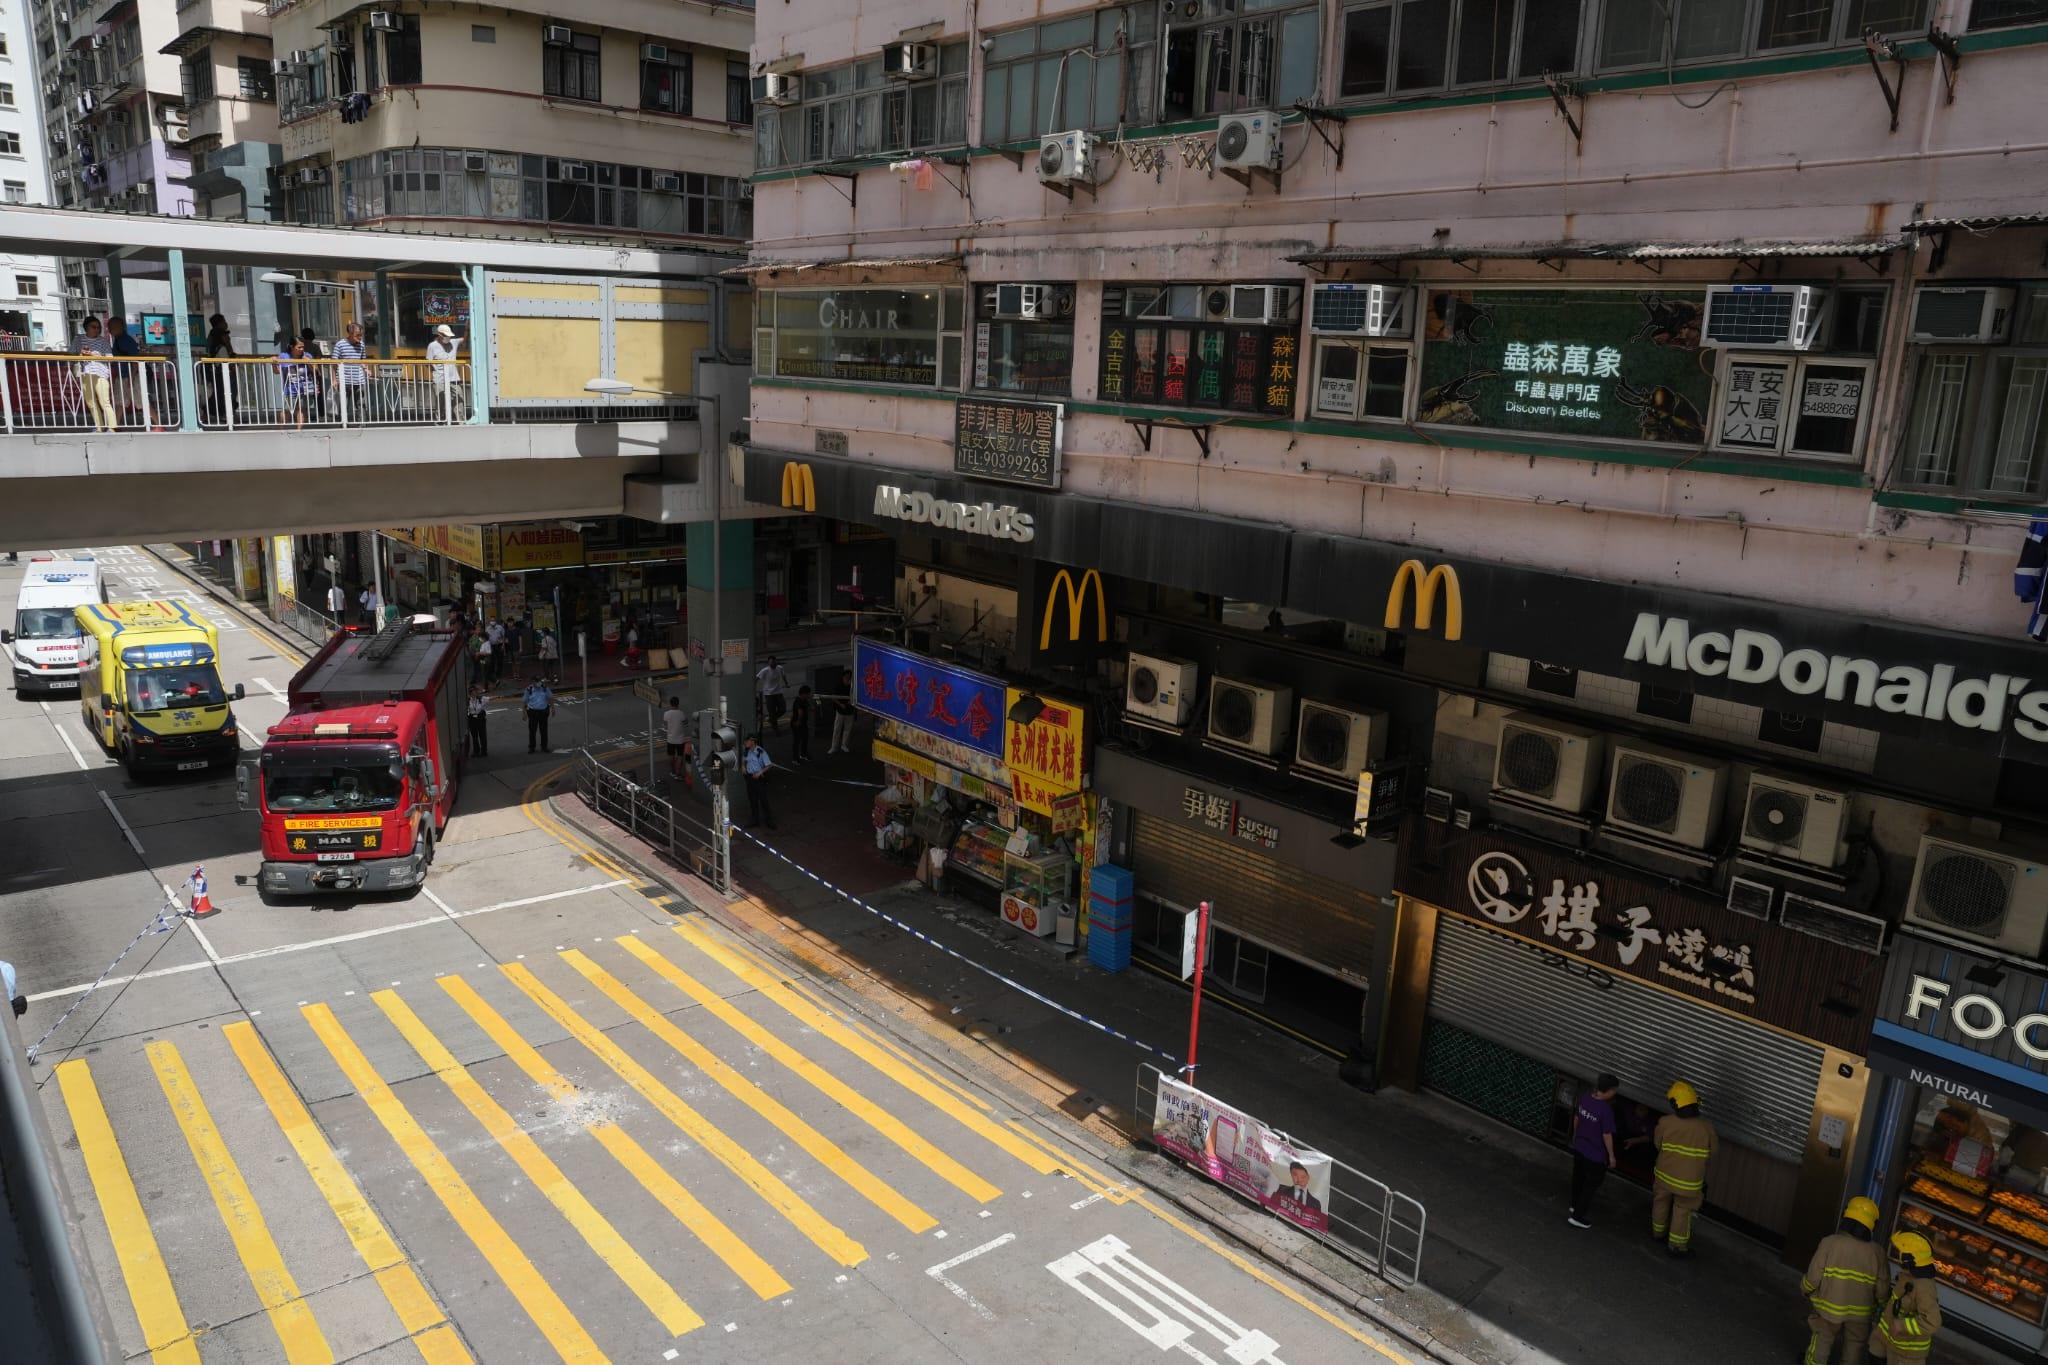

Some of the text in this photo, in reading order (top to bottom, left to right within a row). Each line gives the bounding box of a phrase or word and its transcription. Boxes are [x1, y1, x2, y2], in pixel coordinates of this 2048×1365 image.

[1104, 329, 1126, 395] 金吉拉
[1502, 341, 1622, 378] 蟲森萬象
[1514, 379, 1601, 403] 甲蟲專門店
[1505, 401, 1601, 419] Discovery Beetles
[1727, 395, 1781, 421] 大廈
[1740, 423, 1776, 442] 入口
[873, 484, 1035, 543] McDonald's
[147, 649, 193, 660] AMBULANCE
[1623, 612, 2048, 744] McDonald's
[300, 820, 320, 828] FIRE
[323, 819, 368, 828] SERVICES
[1238, 816, 1279, 840] SUSHI
[318, 837, 352, 845] MAN
[1909, 1068, 1993, 1109] NATURAL
